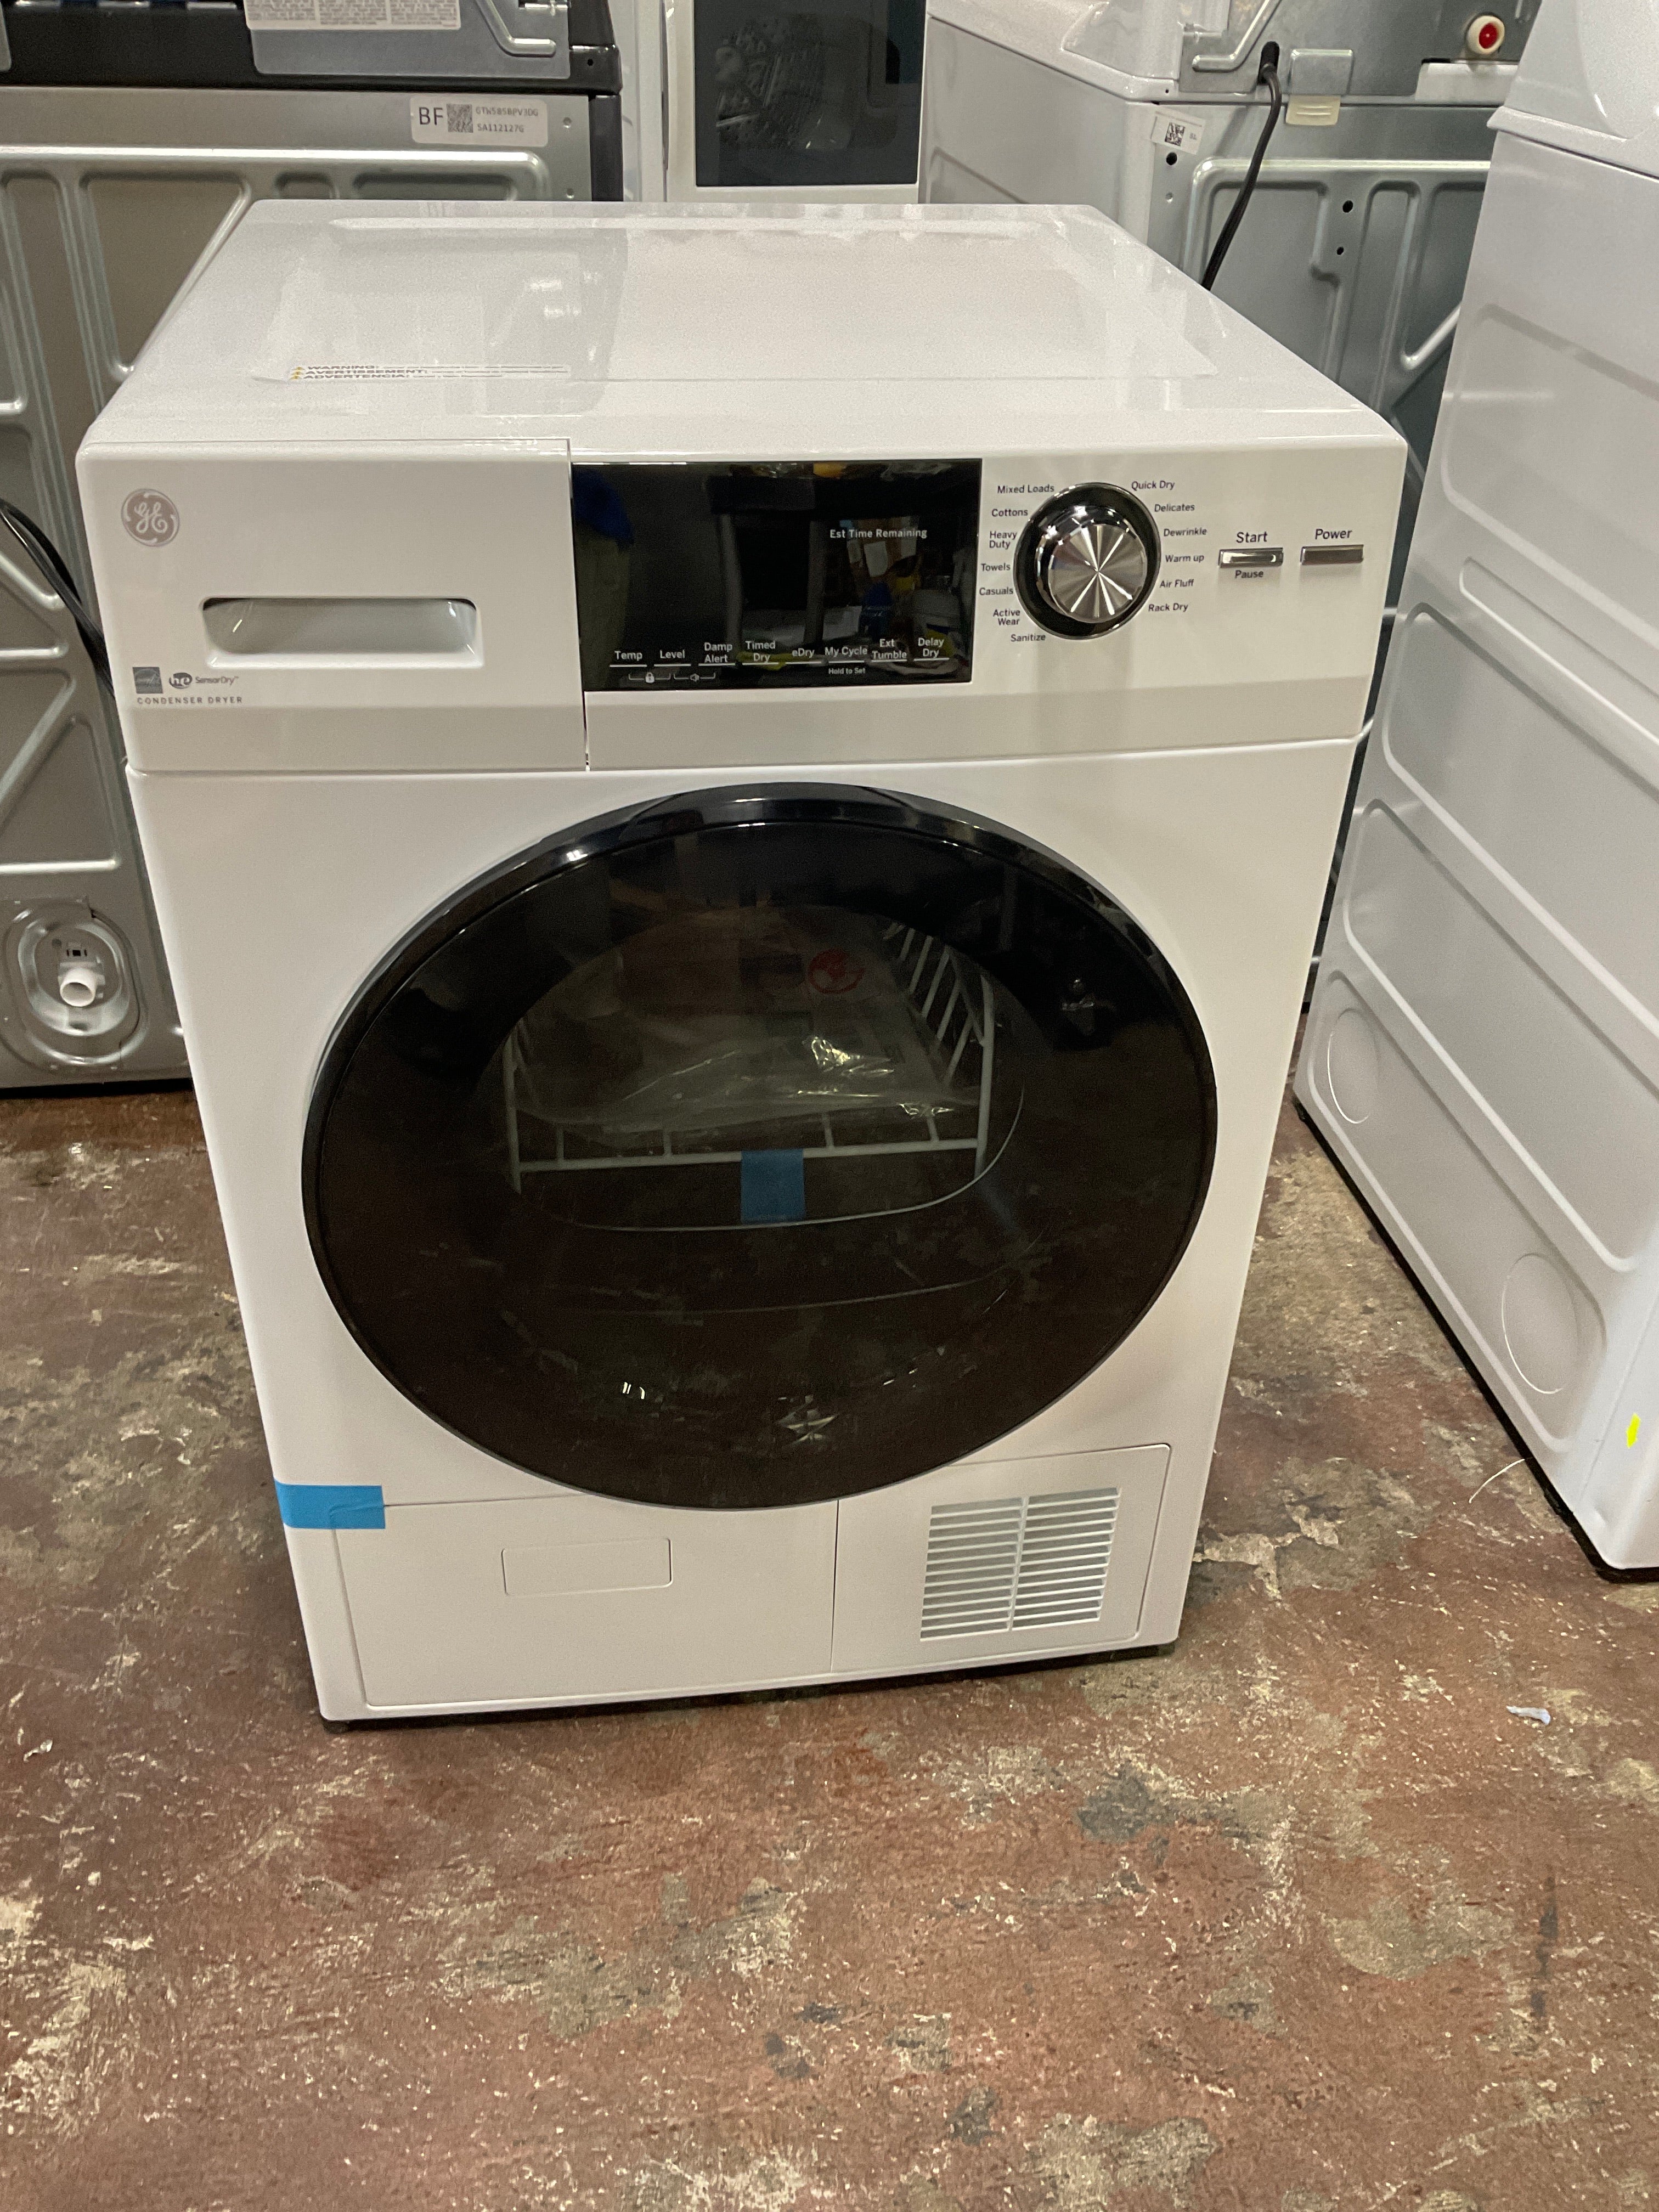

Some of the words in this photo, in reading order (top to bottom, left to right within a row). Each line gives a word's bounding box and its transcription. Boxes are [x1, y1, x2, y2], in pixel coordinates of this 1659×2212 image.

[419, 106, 443, 125] BF
[997, 485, 1025, 494] Mixed
[1028, 484, 1055, 493] Loads
[1131, 481, 1157, 491] Quick
[1159, 480, 1175, 490] Dry
[1154, 503, 1195, 512] Delicates
[991, 509, 1028, 517] Cottons
[830, 529, 845, 538] Est
[848, 529, 873, 538] Time
[876, 529, 928, 539] Remaining
[989, 531, 1017, 540] Heavy
[1164, 527, 1207, 537] Dewrinkle
[1235, 531, 1268, 543] Start
[1314, 528, 1352, 540] Power
[989, 540, 1011, 549] Duty
[1165, 554, 1191, 562] Warm
[1193, 555, 1205, 563] up
[981, 562, 1011, 572] Towels
[1235, 569, 1264, 579] Pause
[1159, 580, 1172, 588] Air
[1175, 578, 1194, 588] Fluff
[979, 586, 1014, 596] Casuals
[1148, 603, 1170, 612] Rack
[1173, 602, 1188, 612] Dry
[992, 608, 1020, 617] Active
[879, 639, 895, 647] Ext
[917, 637, 944, 647] Delay
[1011, 634, 1046, 642] Sanitize
[704, 642, 733, 652] Damp
[745, 640, 776, 650] Timed
[614, 650, 643, 661] Temp
[659, 650, 685, 659] Level
[792, 648, 815, 658] eDry
[825, 647, 839, 658] My
[841, 645, 868, 657] Cycle
[871, 650, 907, 659] Tumble
[922, 648, 939, 658] Dry
[704, 654, 728, 663] Alert
[753, 653, 770, 663] Dry
